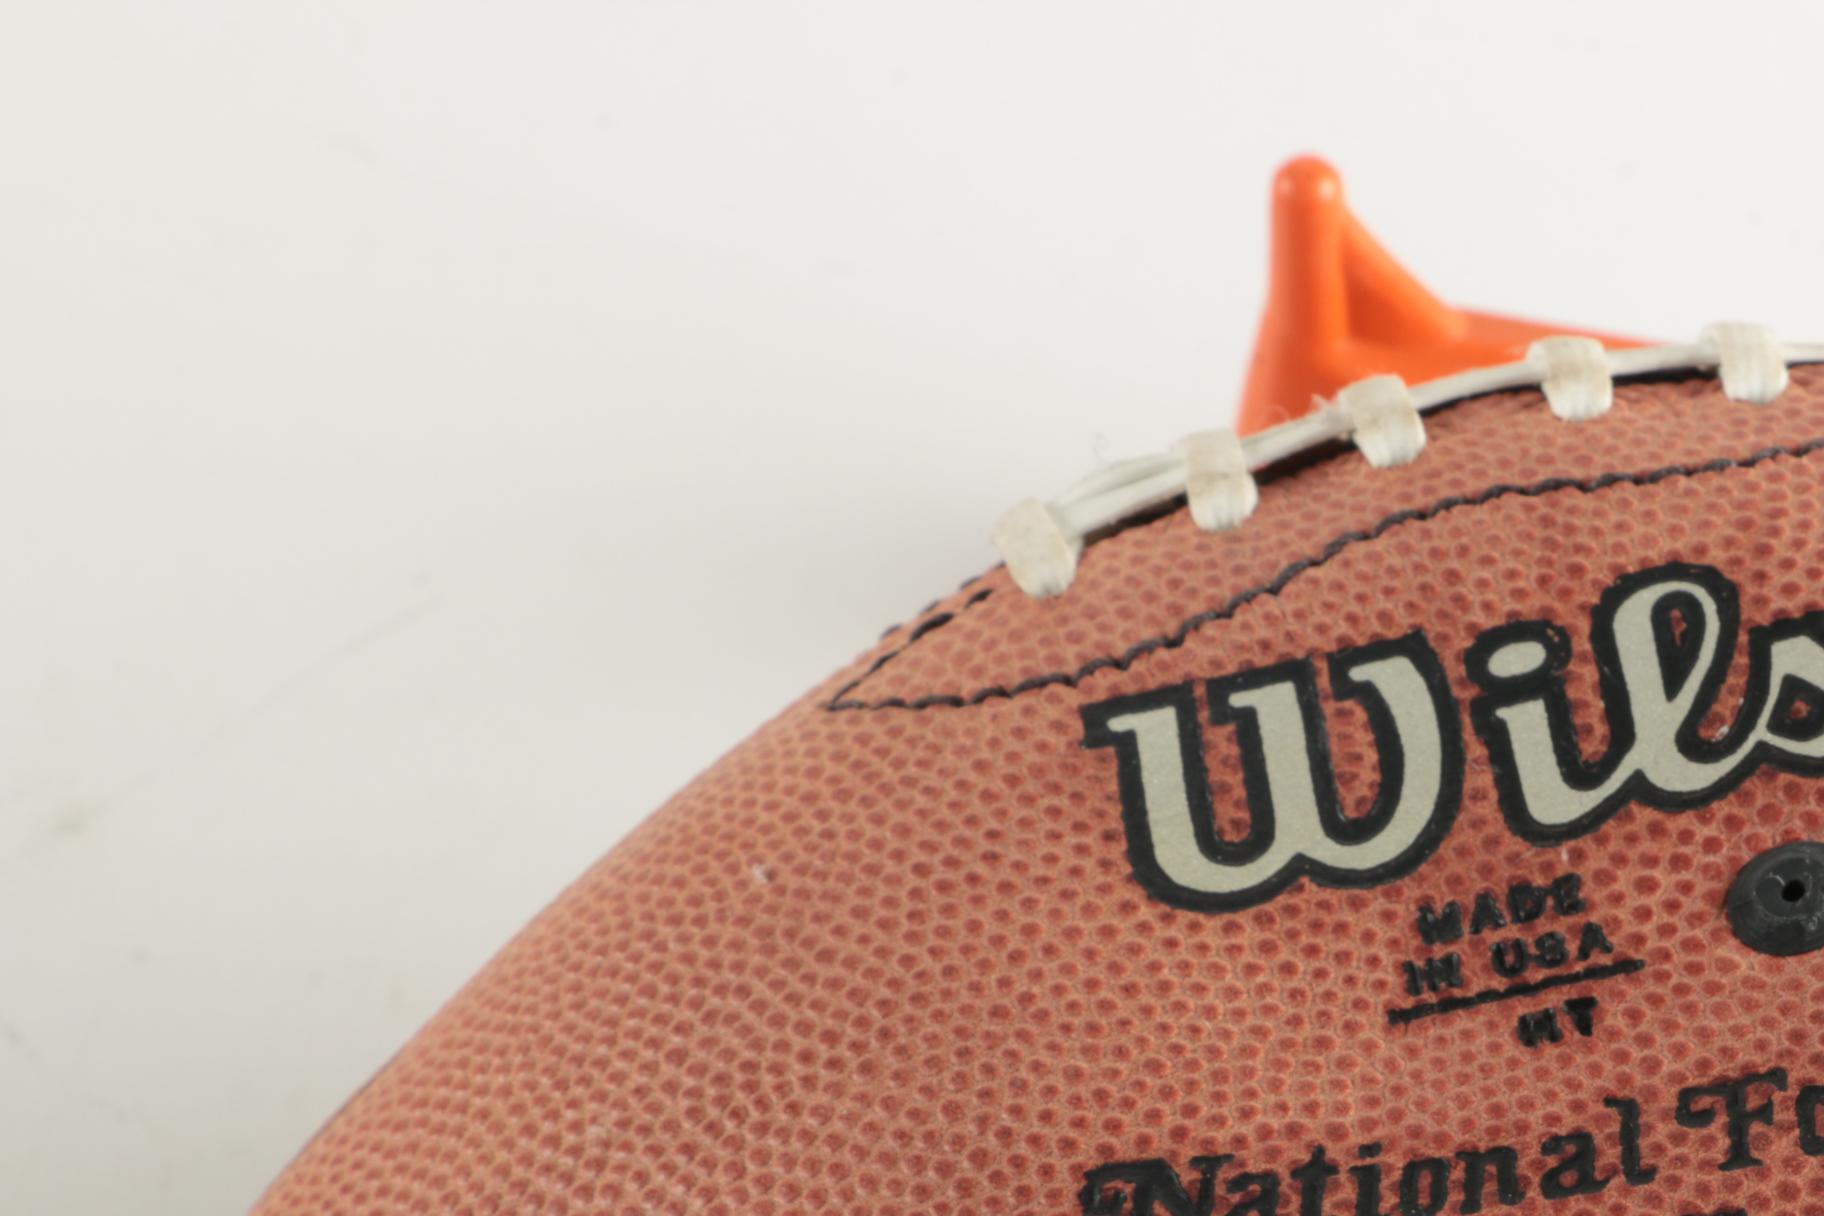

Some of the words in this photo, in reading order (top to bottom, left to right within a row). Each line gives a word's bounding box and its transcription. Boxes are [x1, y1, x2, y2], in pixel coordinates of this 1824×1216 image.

[1417, 872, 1587, 946] MADE
[1404, 948, 1465, 996] IN
[1490, 931, 1615, 978] USA
